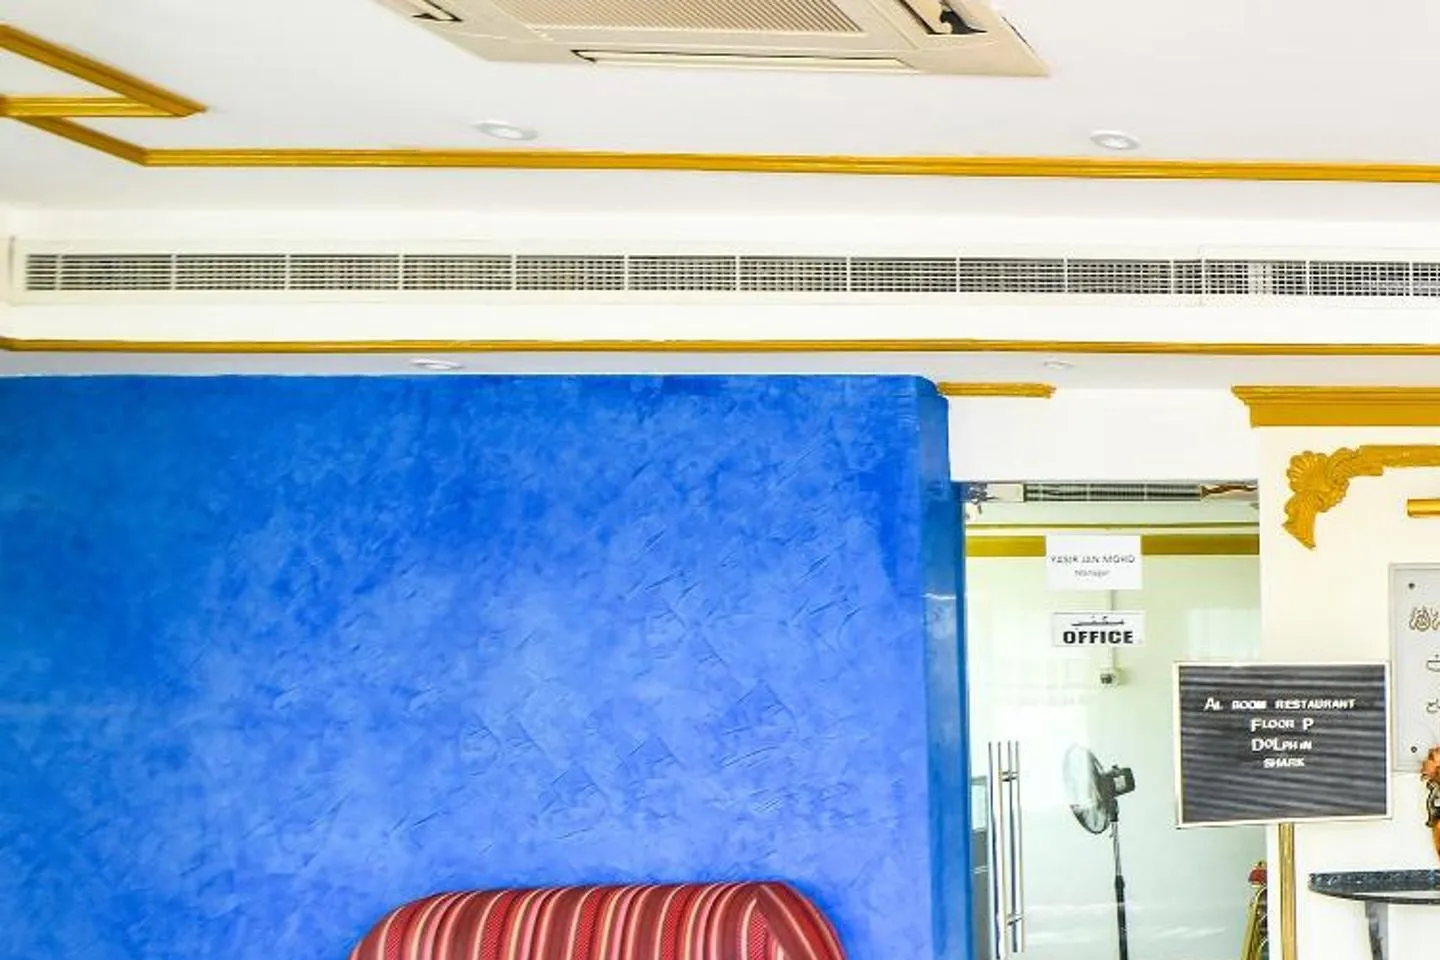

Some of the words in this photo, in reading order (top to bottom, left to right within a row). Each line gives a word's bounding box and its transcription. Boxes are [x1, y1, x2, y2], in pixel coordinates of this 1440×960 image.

[1063, 631, 1133, 644] OFFICE
[1232, 700, 1267, 710] BOOM
[1275, 699, 1356, 710] RESTAURANT
[1251, 718, 1294, 732] FLOOR
[1303, 718, 1314, 731] P
[1252, 738, 1312, 751] DOLPHIN
[1264, 758, 1304, 768] SHARK
